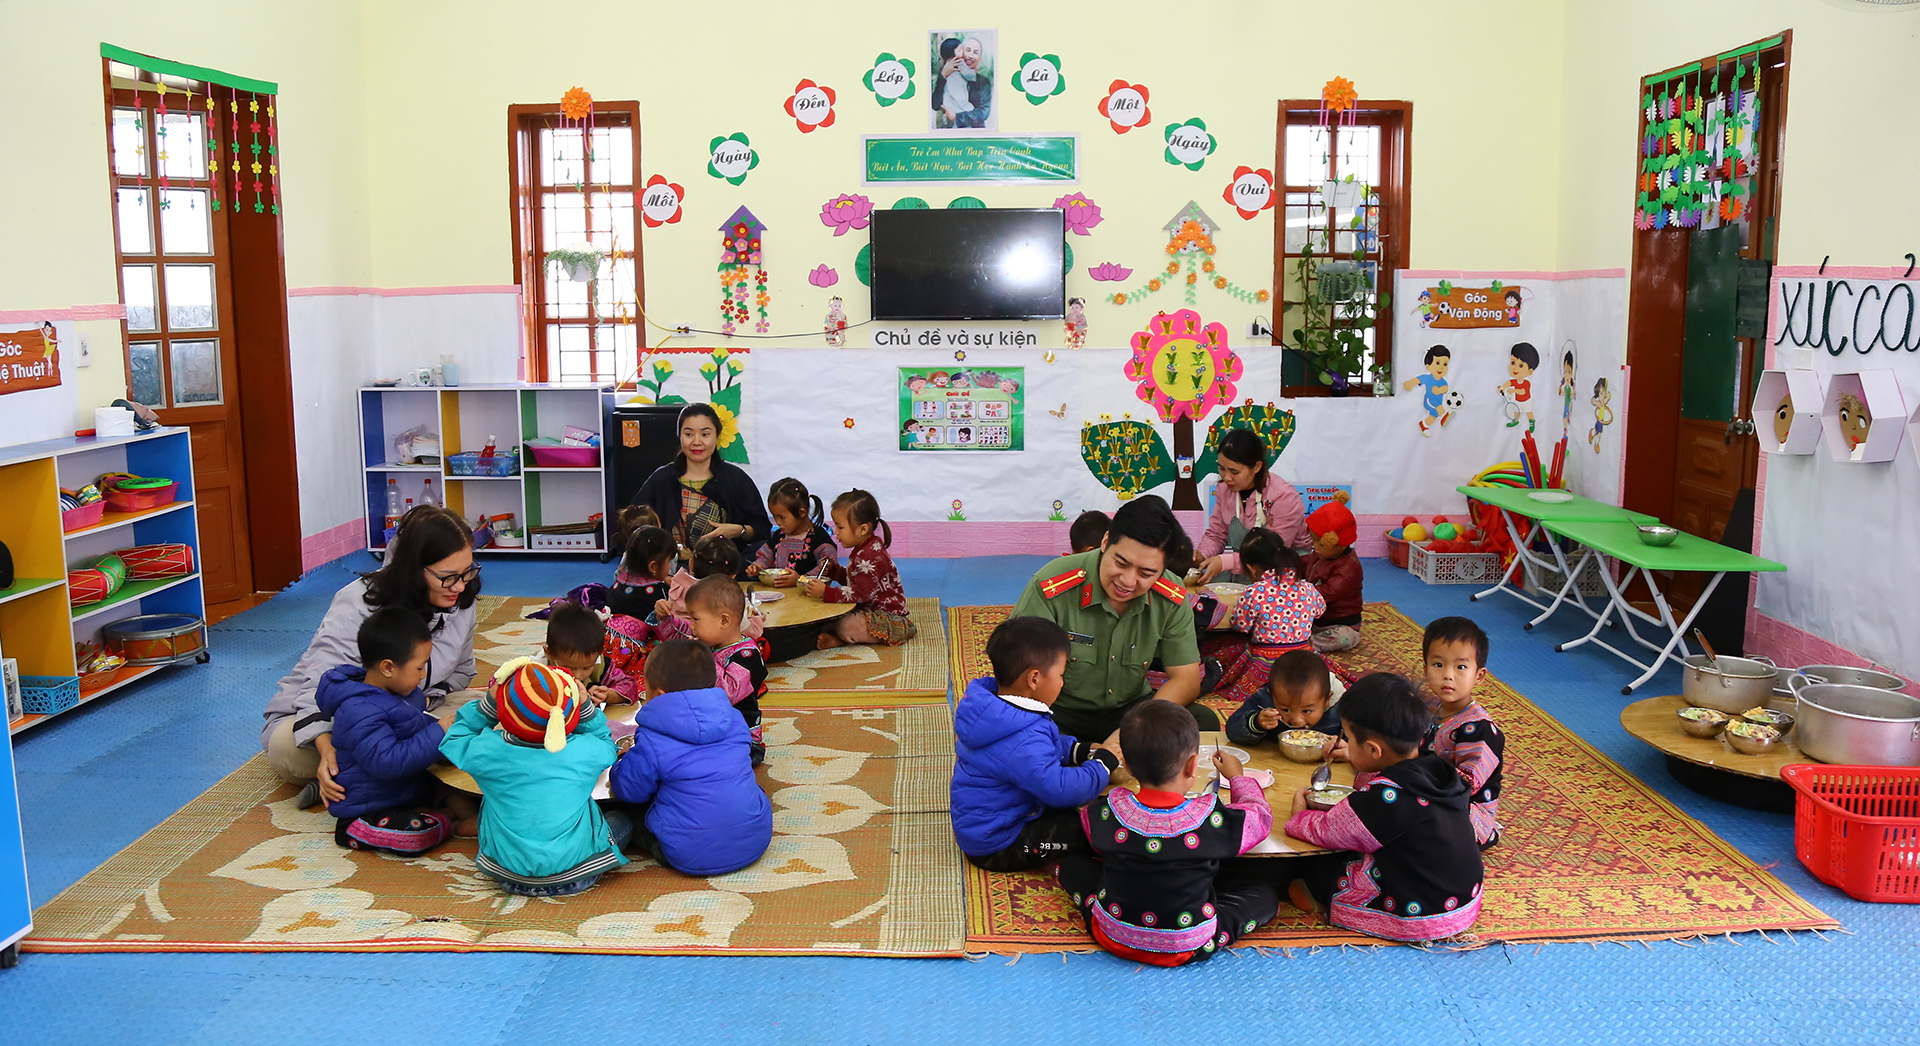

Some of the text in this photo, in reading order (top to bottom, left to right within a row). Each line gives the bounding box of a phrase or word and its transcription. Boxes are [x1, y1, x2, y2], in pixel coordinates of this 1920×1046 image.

[874, 68, 905, 85] Lớp
[1026, 69, 1050, 83] Là
[795, 94, 826, 110] Đến
[1110, 98, 1139, 113] Một
[1169, 134, 1209, 150] Ngày
[712, 149, 752, 165] Ngày
[1235, 183, 1266, 196] Vui
[1464, 292, 1488, 303] Góc
[1449, 307, 1502, 321] Vận Động
[875, 328, 1037, 348] Chủ đề và sự kiện
[0, 340, 22, 357] Góc
[11, 361, 45, 381] Thuật
